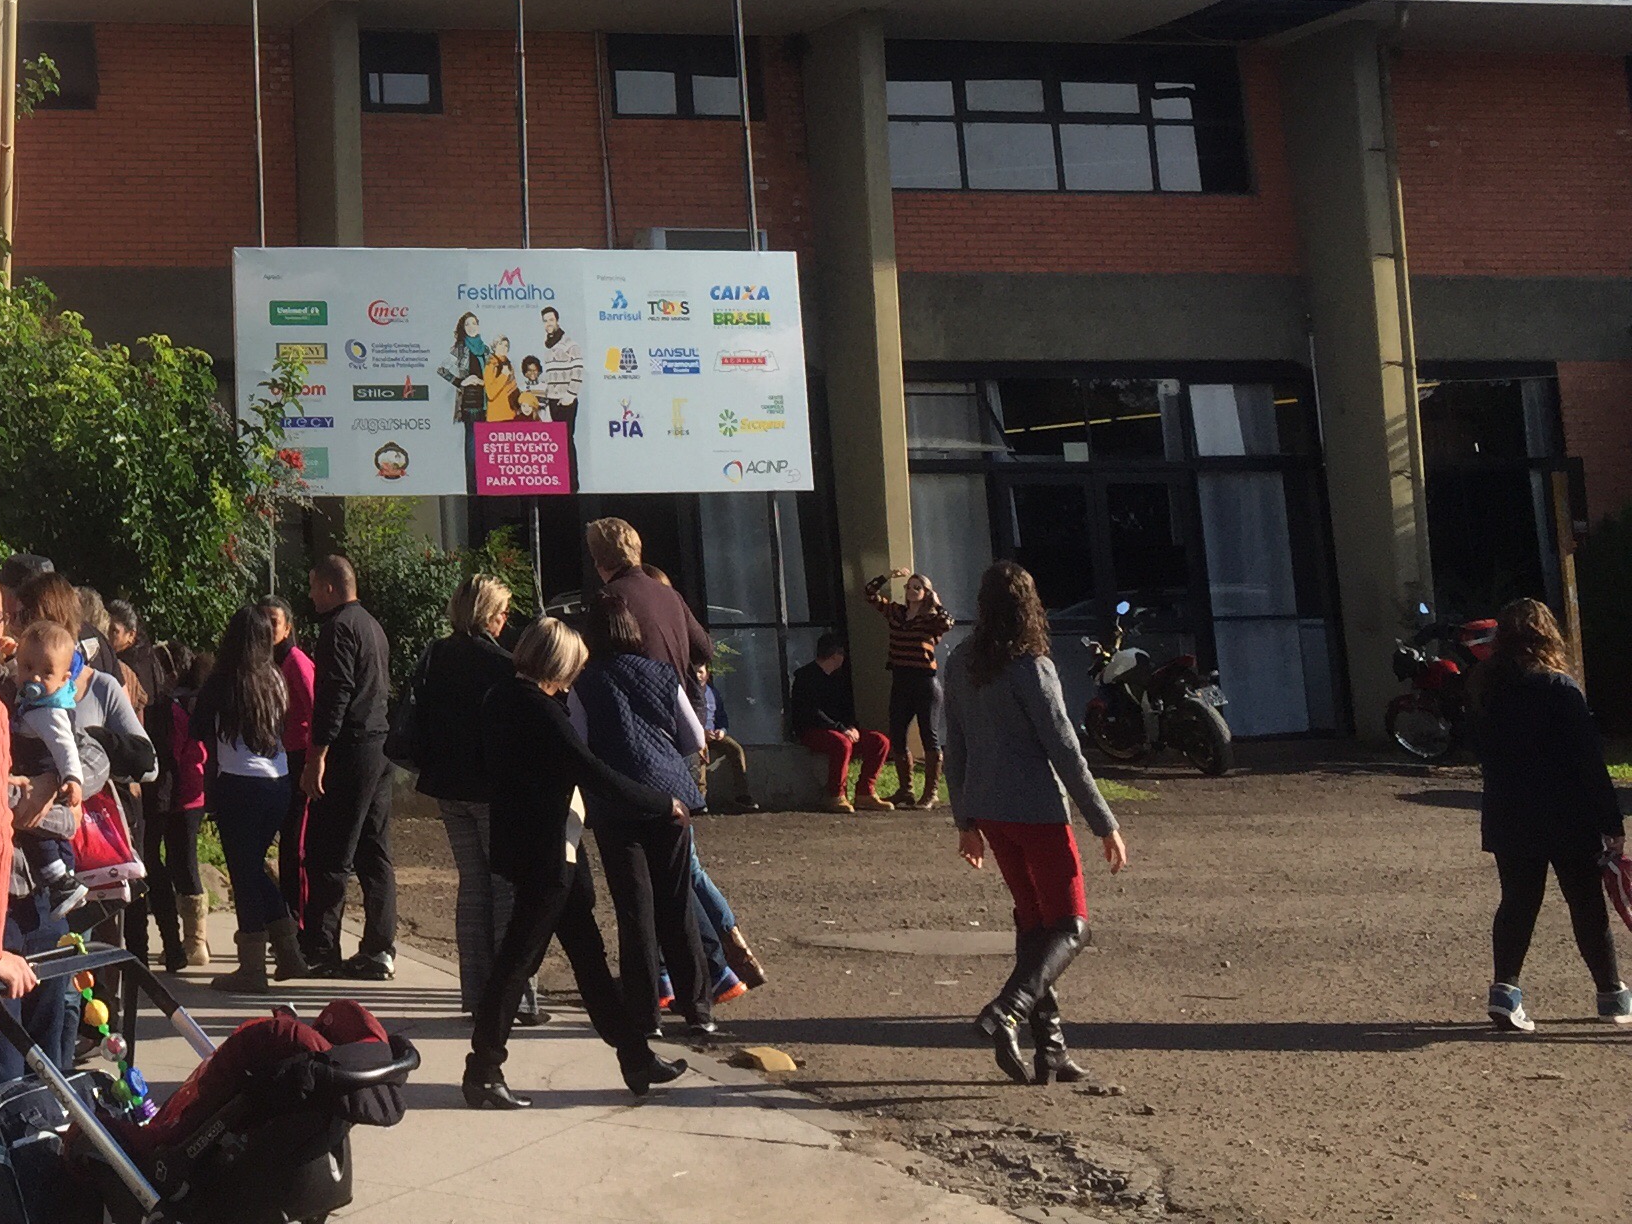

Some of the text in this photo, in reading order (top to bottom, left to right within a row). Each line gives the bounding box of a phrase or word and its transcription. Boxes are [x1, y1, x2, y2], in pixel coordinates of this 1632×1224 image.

[458, 283, 555, 301] Festimalha
[710, 285, 770, 301] CAIXA
[599, 310, 642, 321] Banrisul
[713, 312, 771, 326] BRASIL
[483, 442, 559, 453] ESTE EVENTO
[497, 454, 529, 464] FEITO
[531, 454, 555, 464] POR
[498, 465, 548, 475] TODOS E
[486, 476, 517, 486] PARA
